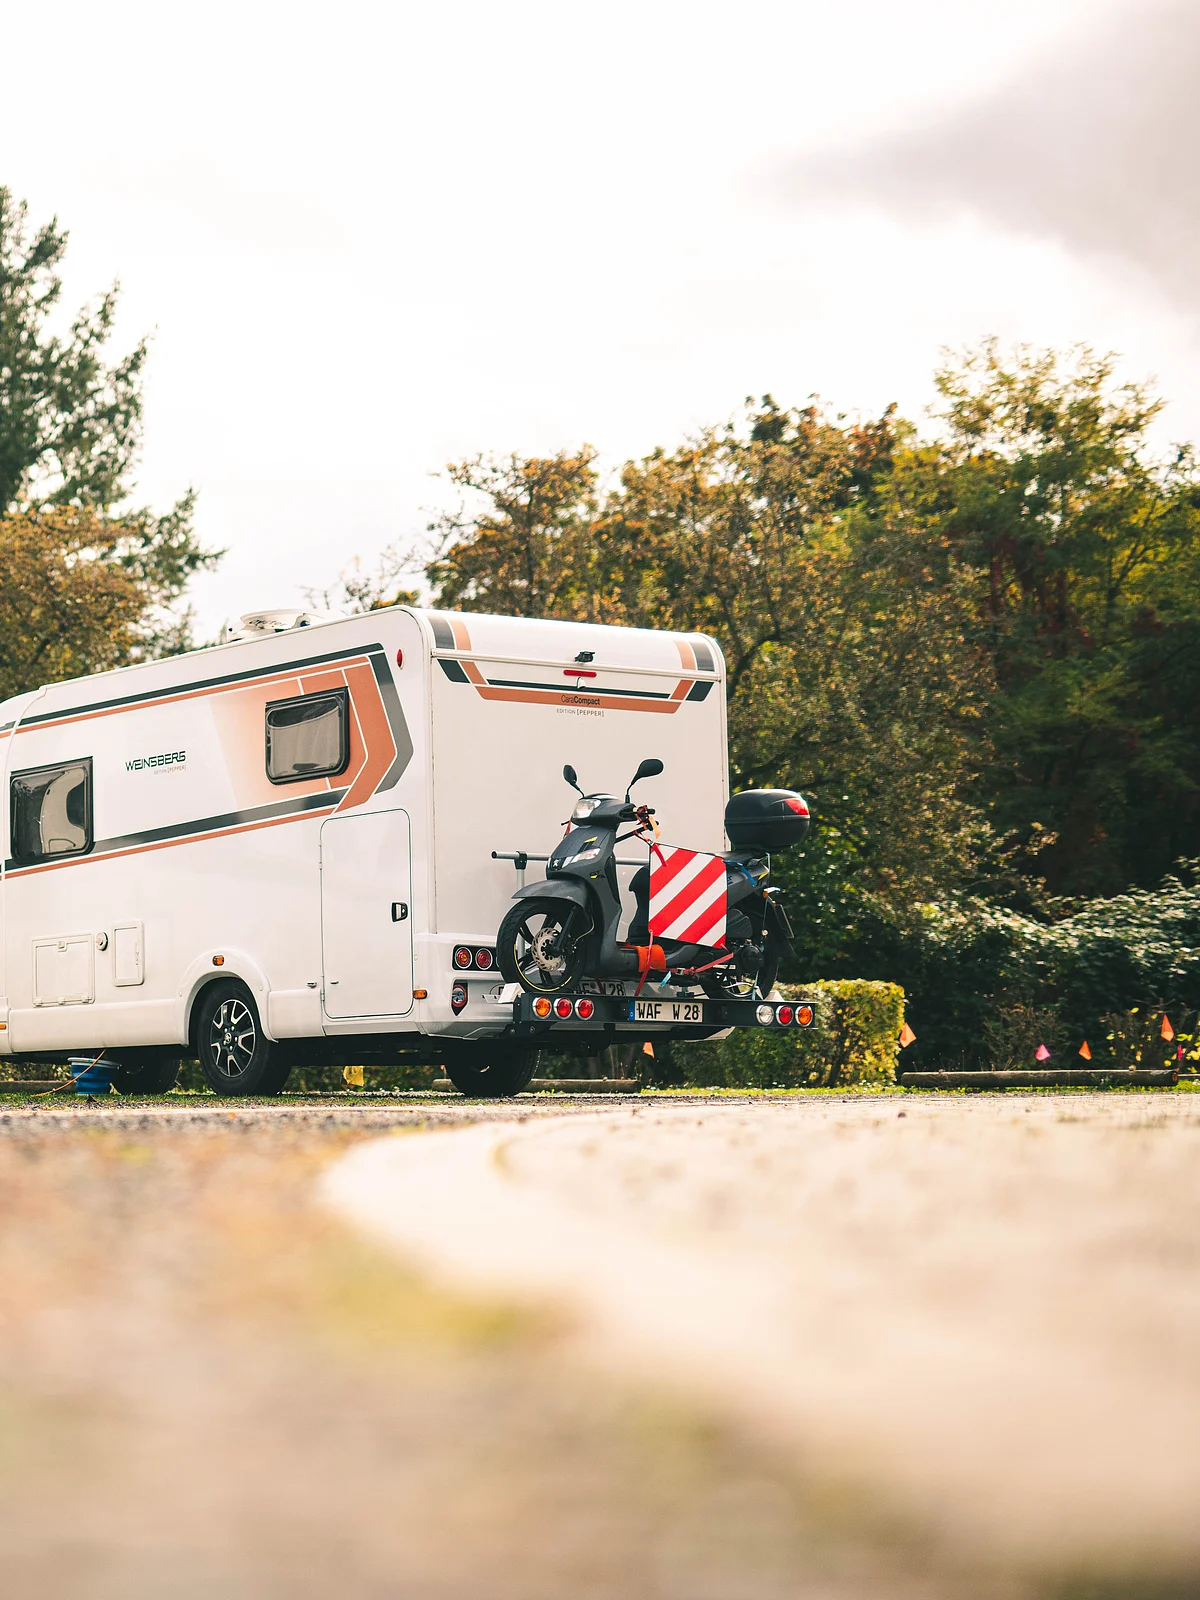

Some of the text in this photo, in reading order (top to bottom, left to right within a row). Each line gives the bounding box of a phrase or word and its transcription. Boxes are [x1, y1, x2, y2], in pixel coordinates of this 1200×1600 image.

[560, 694, 601, 706] CaraCompact
[637, 1002, 699, 1020] WAF W 28
